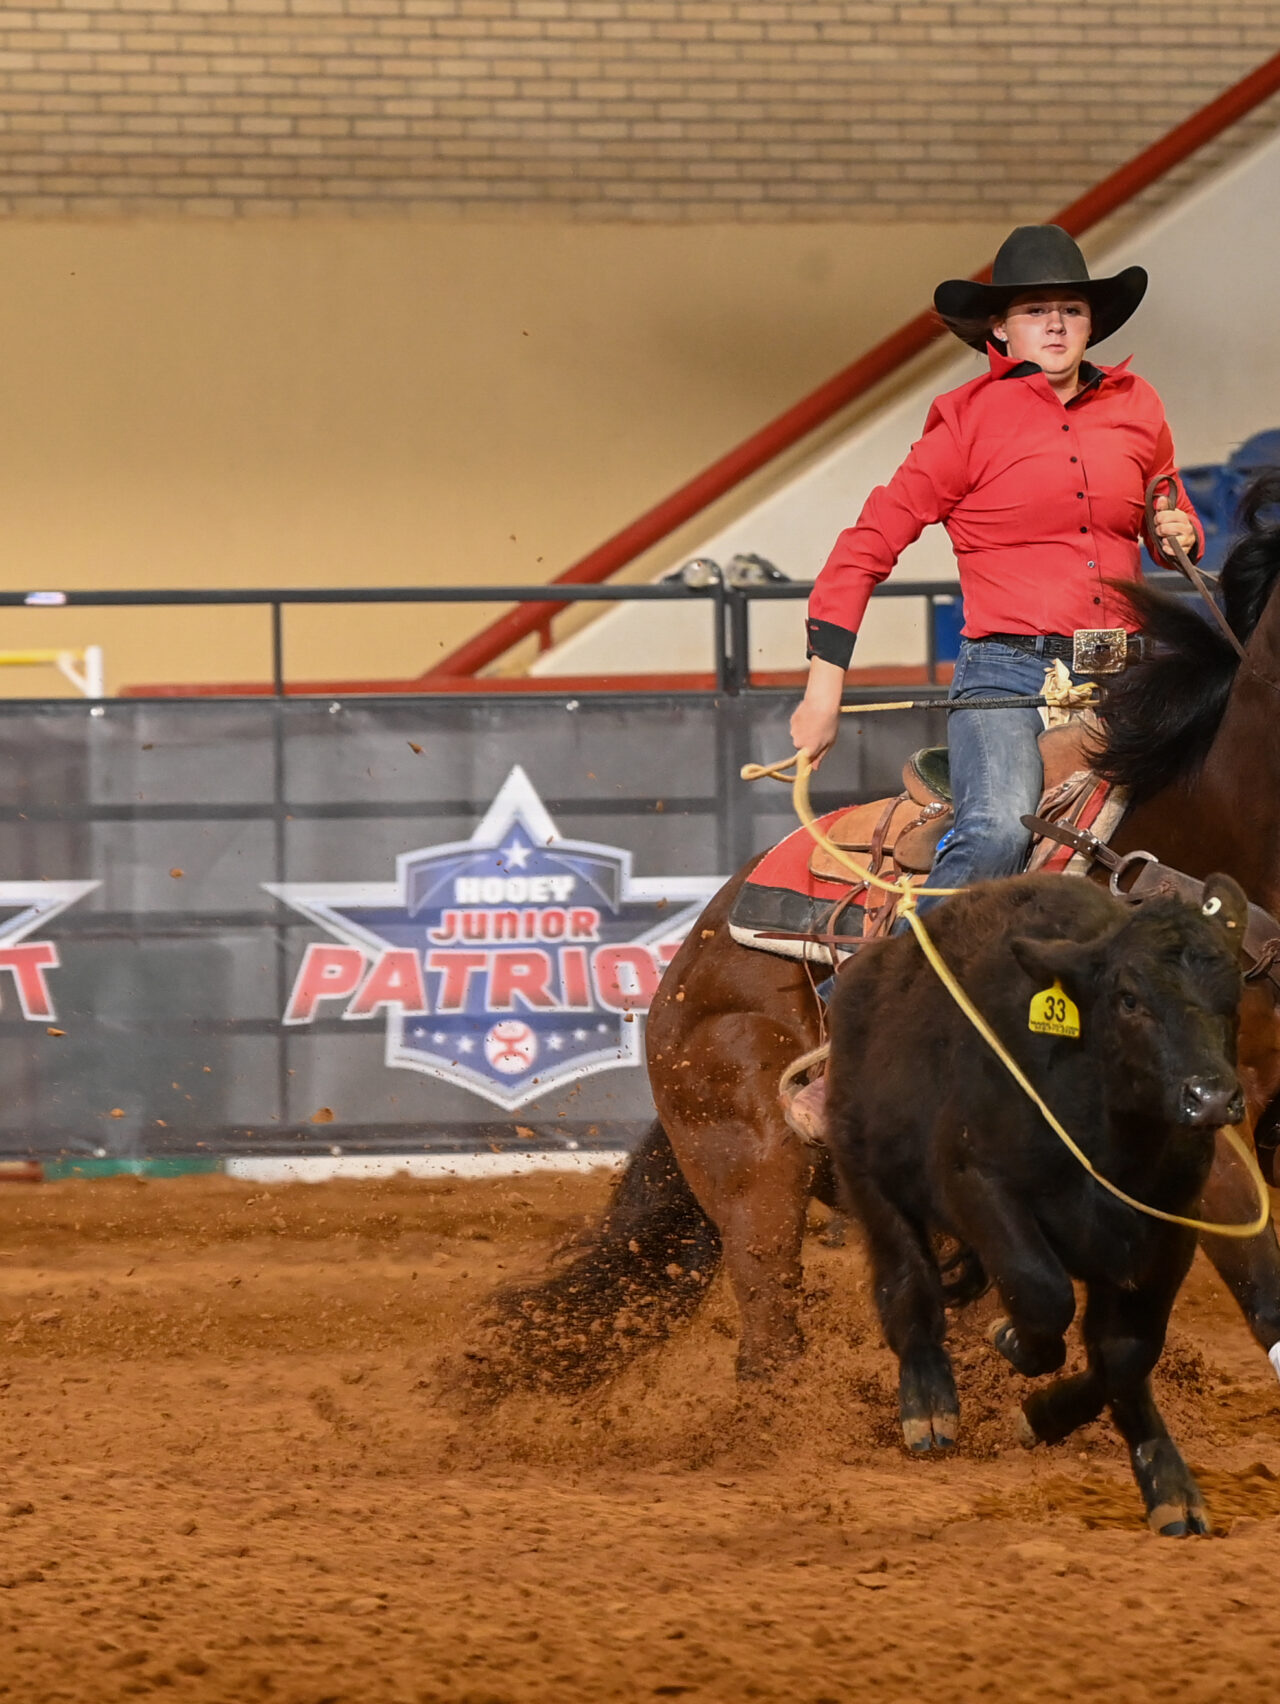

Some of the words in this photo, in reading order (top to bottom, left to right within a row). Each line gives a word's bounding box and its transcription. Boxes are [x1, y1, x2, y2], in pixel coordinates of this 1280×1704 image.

[455, 876, 576, 904] HOOEY
[427, 907, 601, 945] JUNIOR
[282, 940, 686, 1025] PATRIO
[1044, 996, 1066, 1023] 33
